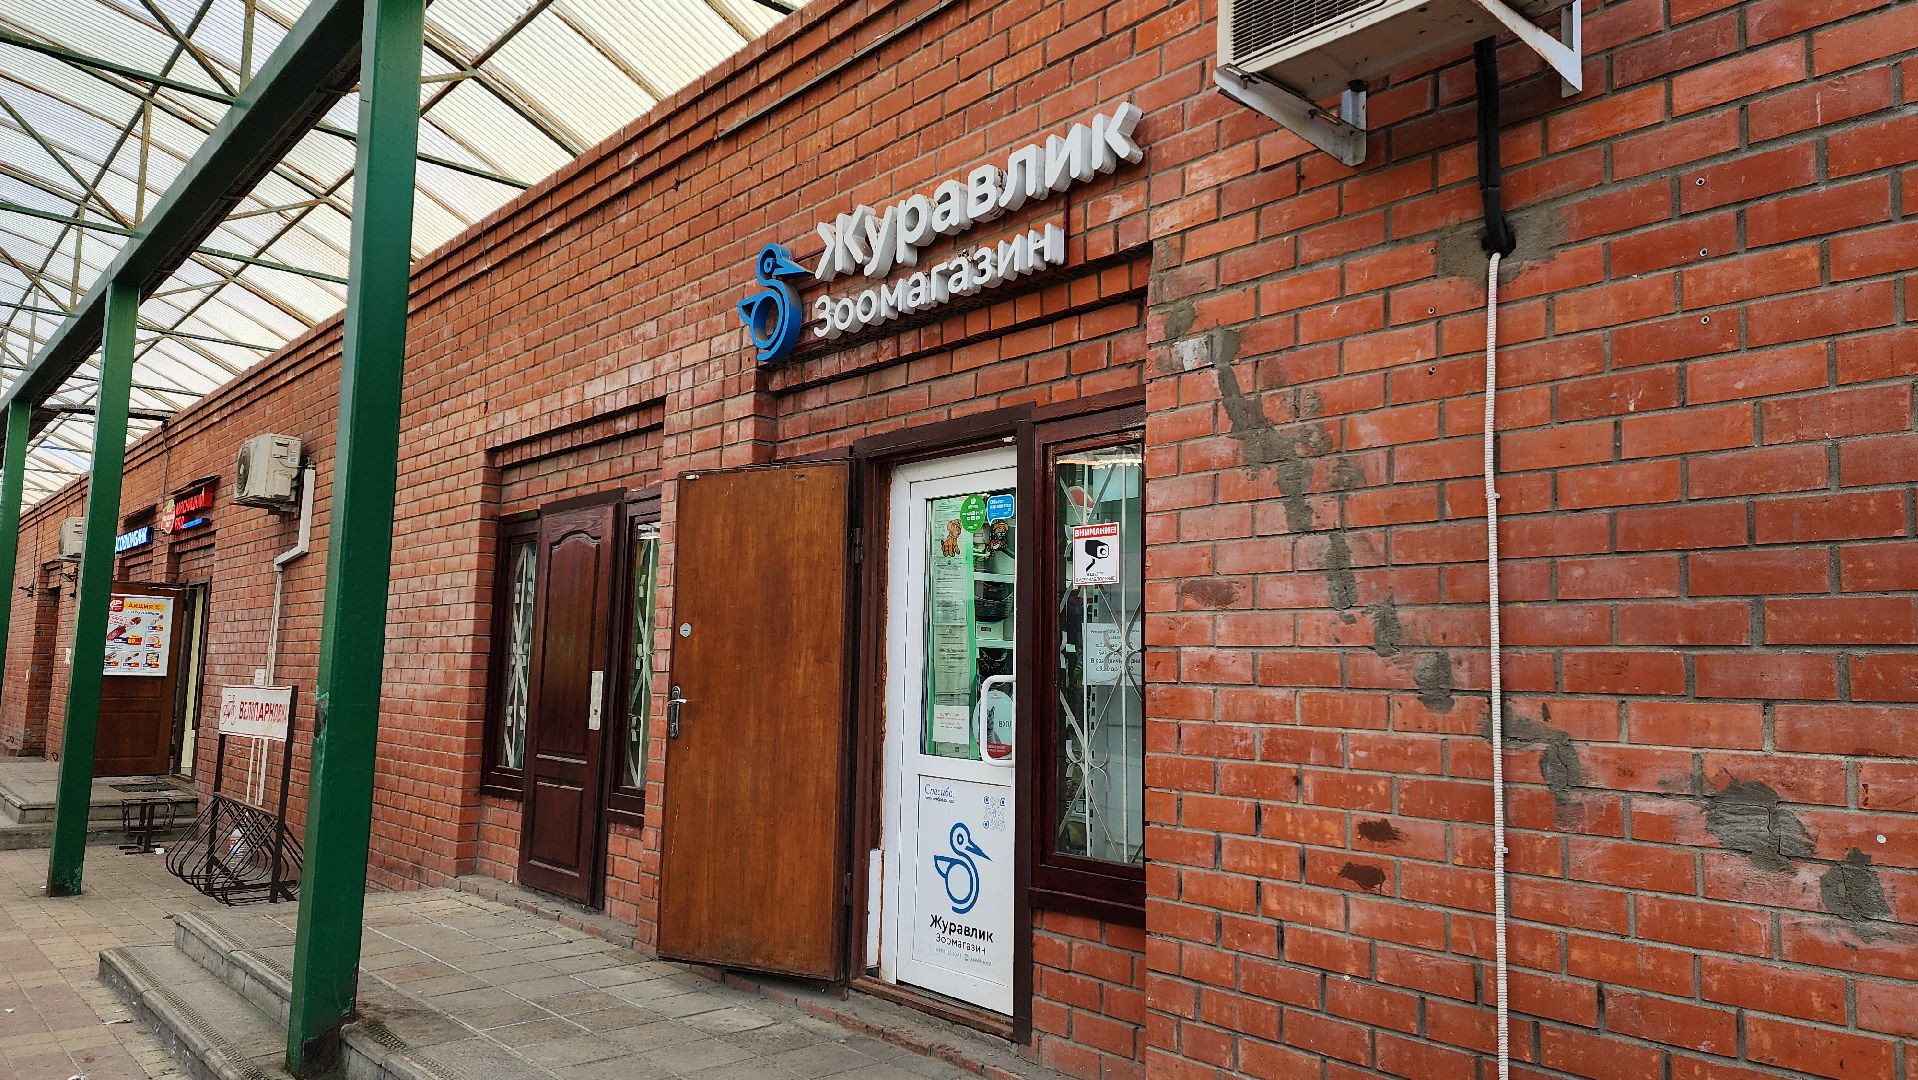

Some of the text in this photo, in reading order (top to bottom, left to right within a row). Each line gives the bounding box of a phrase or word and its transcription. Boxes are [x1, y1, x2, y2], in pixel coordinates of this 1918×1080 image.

[815, 101, 1144, 281] Журавлик
[813, 222, 1065, 339] Зоомагазин
[1075, 525, 1117, 537] ВНИМАНИЕ!
[930, 914, 994, 943] Журавлик
[935, 932, 986, 955] Зоомагазин
